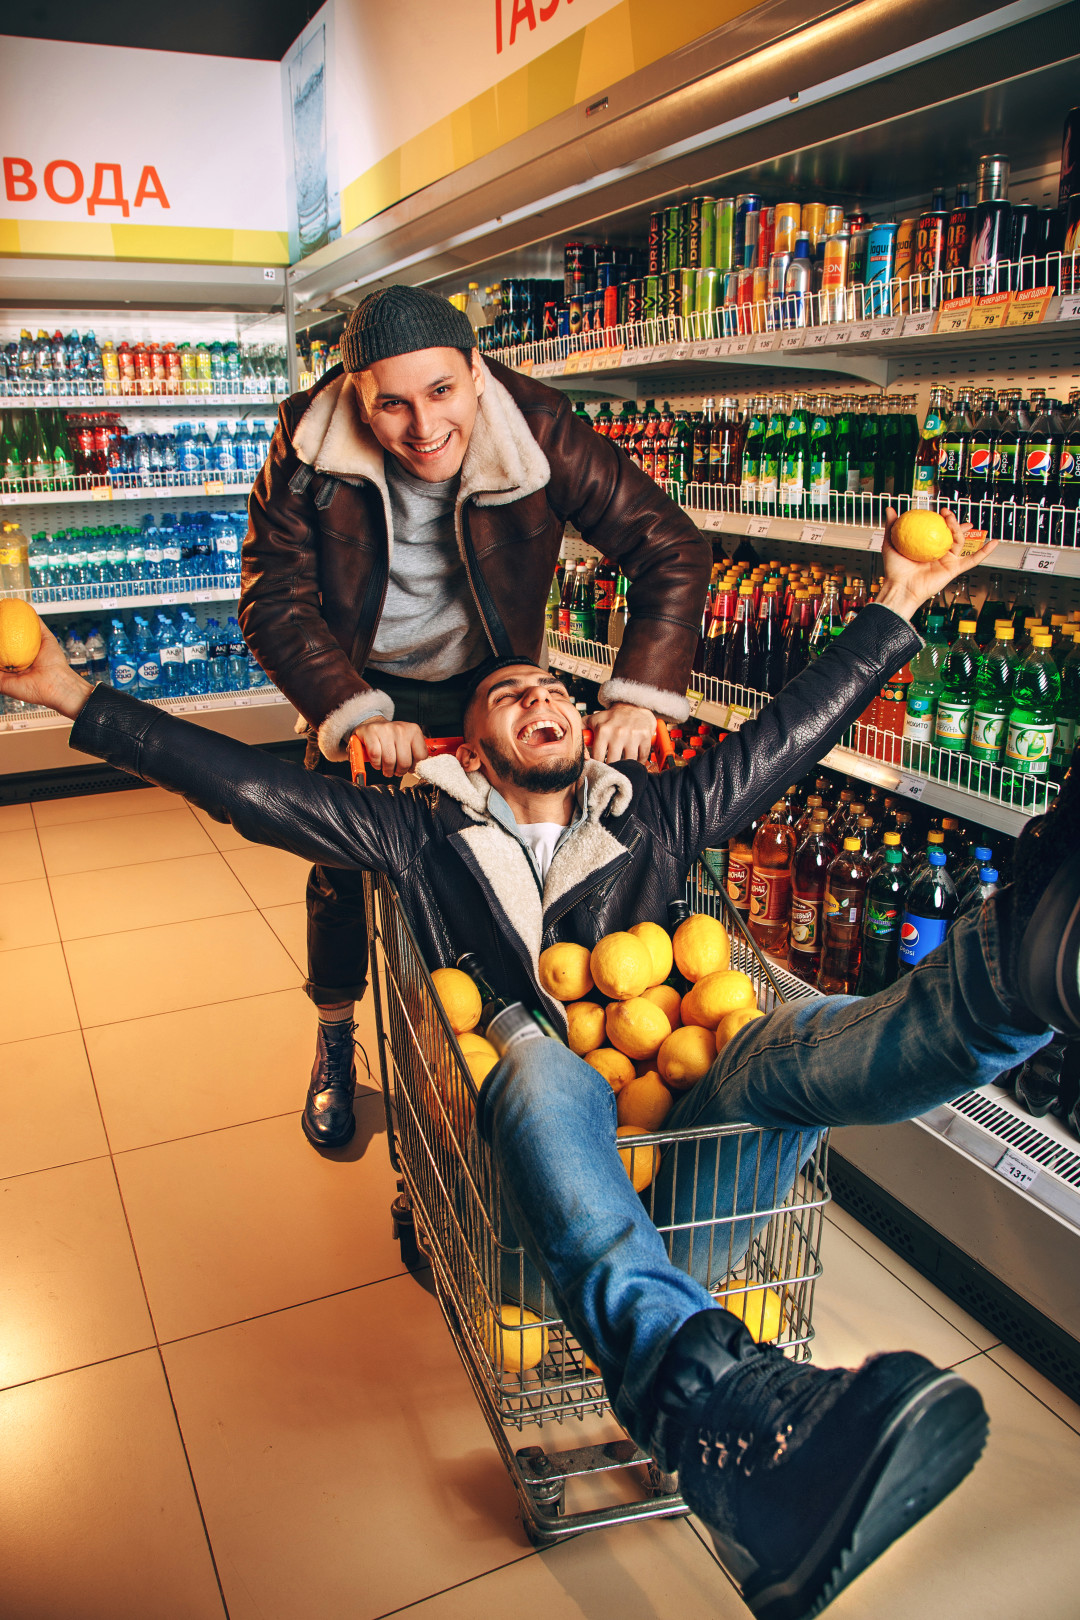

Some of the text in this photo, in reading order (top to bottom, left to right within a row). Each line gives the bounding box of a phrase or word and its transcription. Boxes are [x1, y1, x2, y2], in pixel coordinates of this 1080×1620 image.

[2, 156, 171, 218] ВОДА
[995, 293, 1008, 303] ЦЕНА
[1018, 287, 1048, 301] ВЫГОДНО
[958, 297, 971, 307] ЦЕНА
[947, 449, 955, 471] pepsi
[1000, 451, 1008, 474] pepsi
[1038, 560, 1050, 570] 62
[1009, 1166, 1027, 1182] 131
